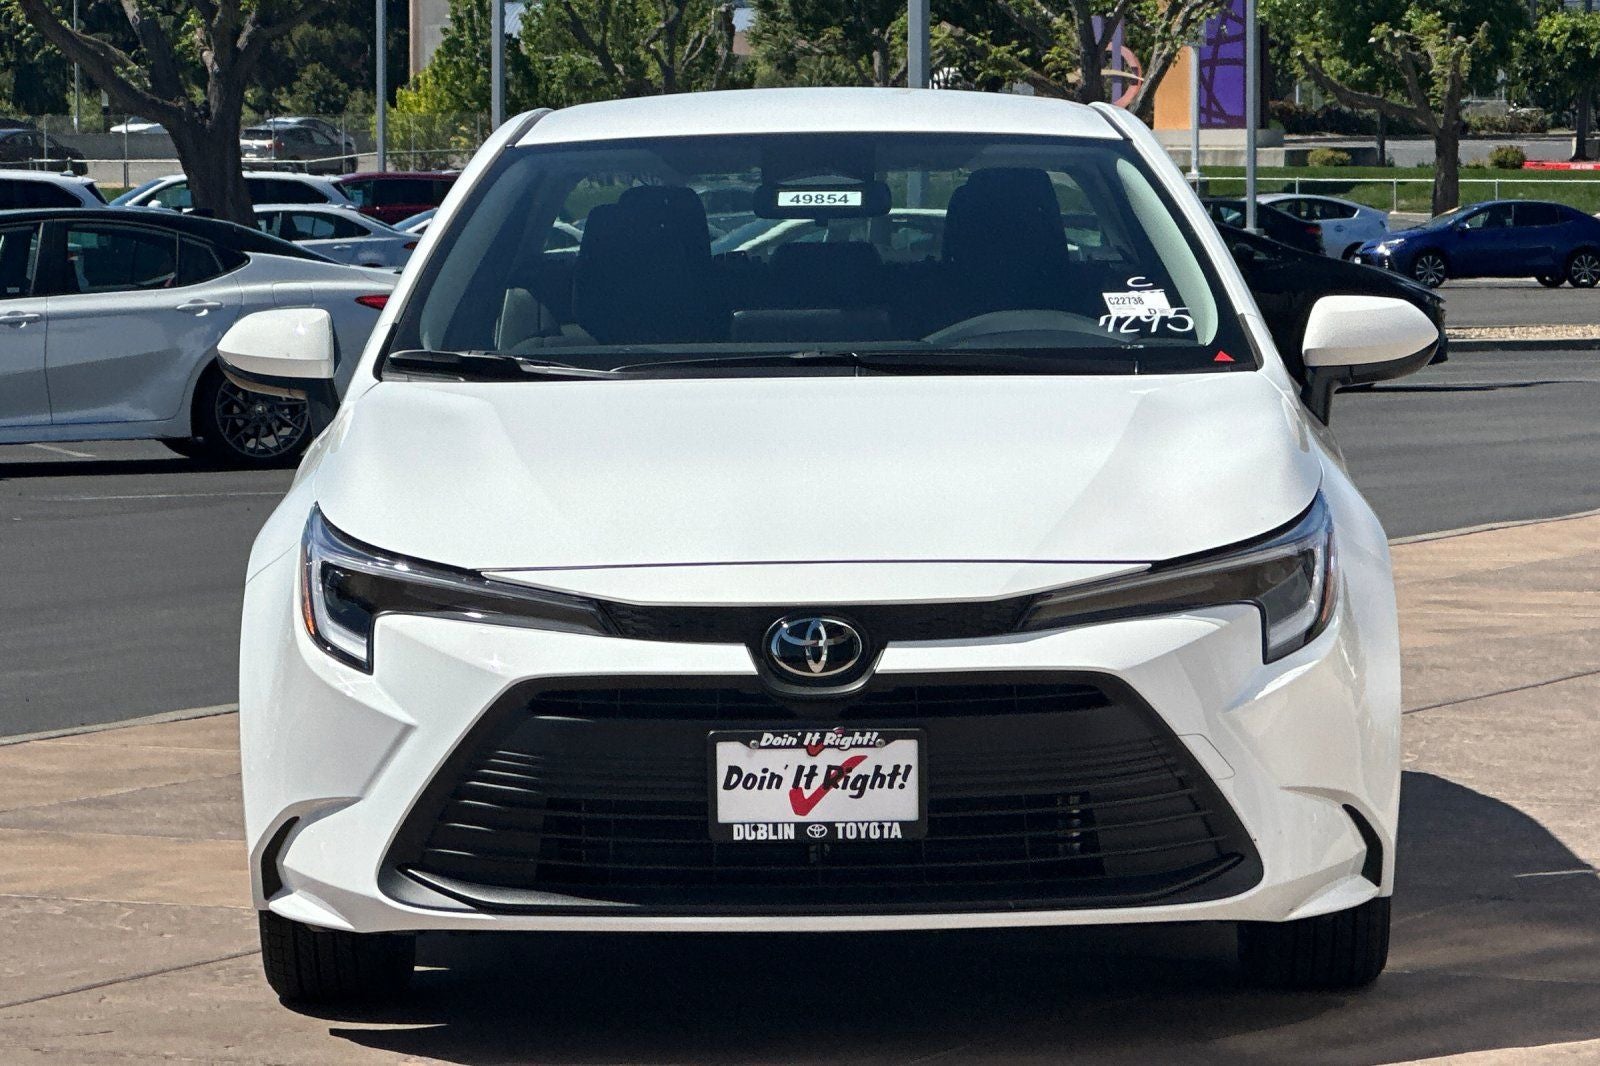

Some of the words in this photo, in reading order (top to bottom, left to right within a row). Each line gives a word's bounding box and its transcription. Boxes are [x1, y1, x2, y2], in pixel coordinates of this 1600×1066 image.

[789, 194, 850, 205] 49854
[759, 732, 802, 747] Doin'
[803, 732, 821, 746] It
[822, 732, 879, 750] Right!
[722, 763, 789, 791] Doin'
[791, 764, 818, 790] It
[822, 764, 913, 799] Right!
[732, 823, 795, 841] DUBLIN
[834, 822, 902, 840] TOYOTA
